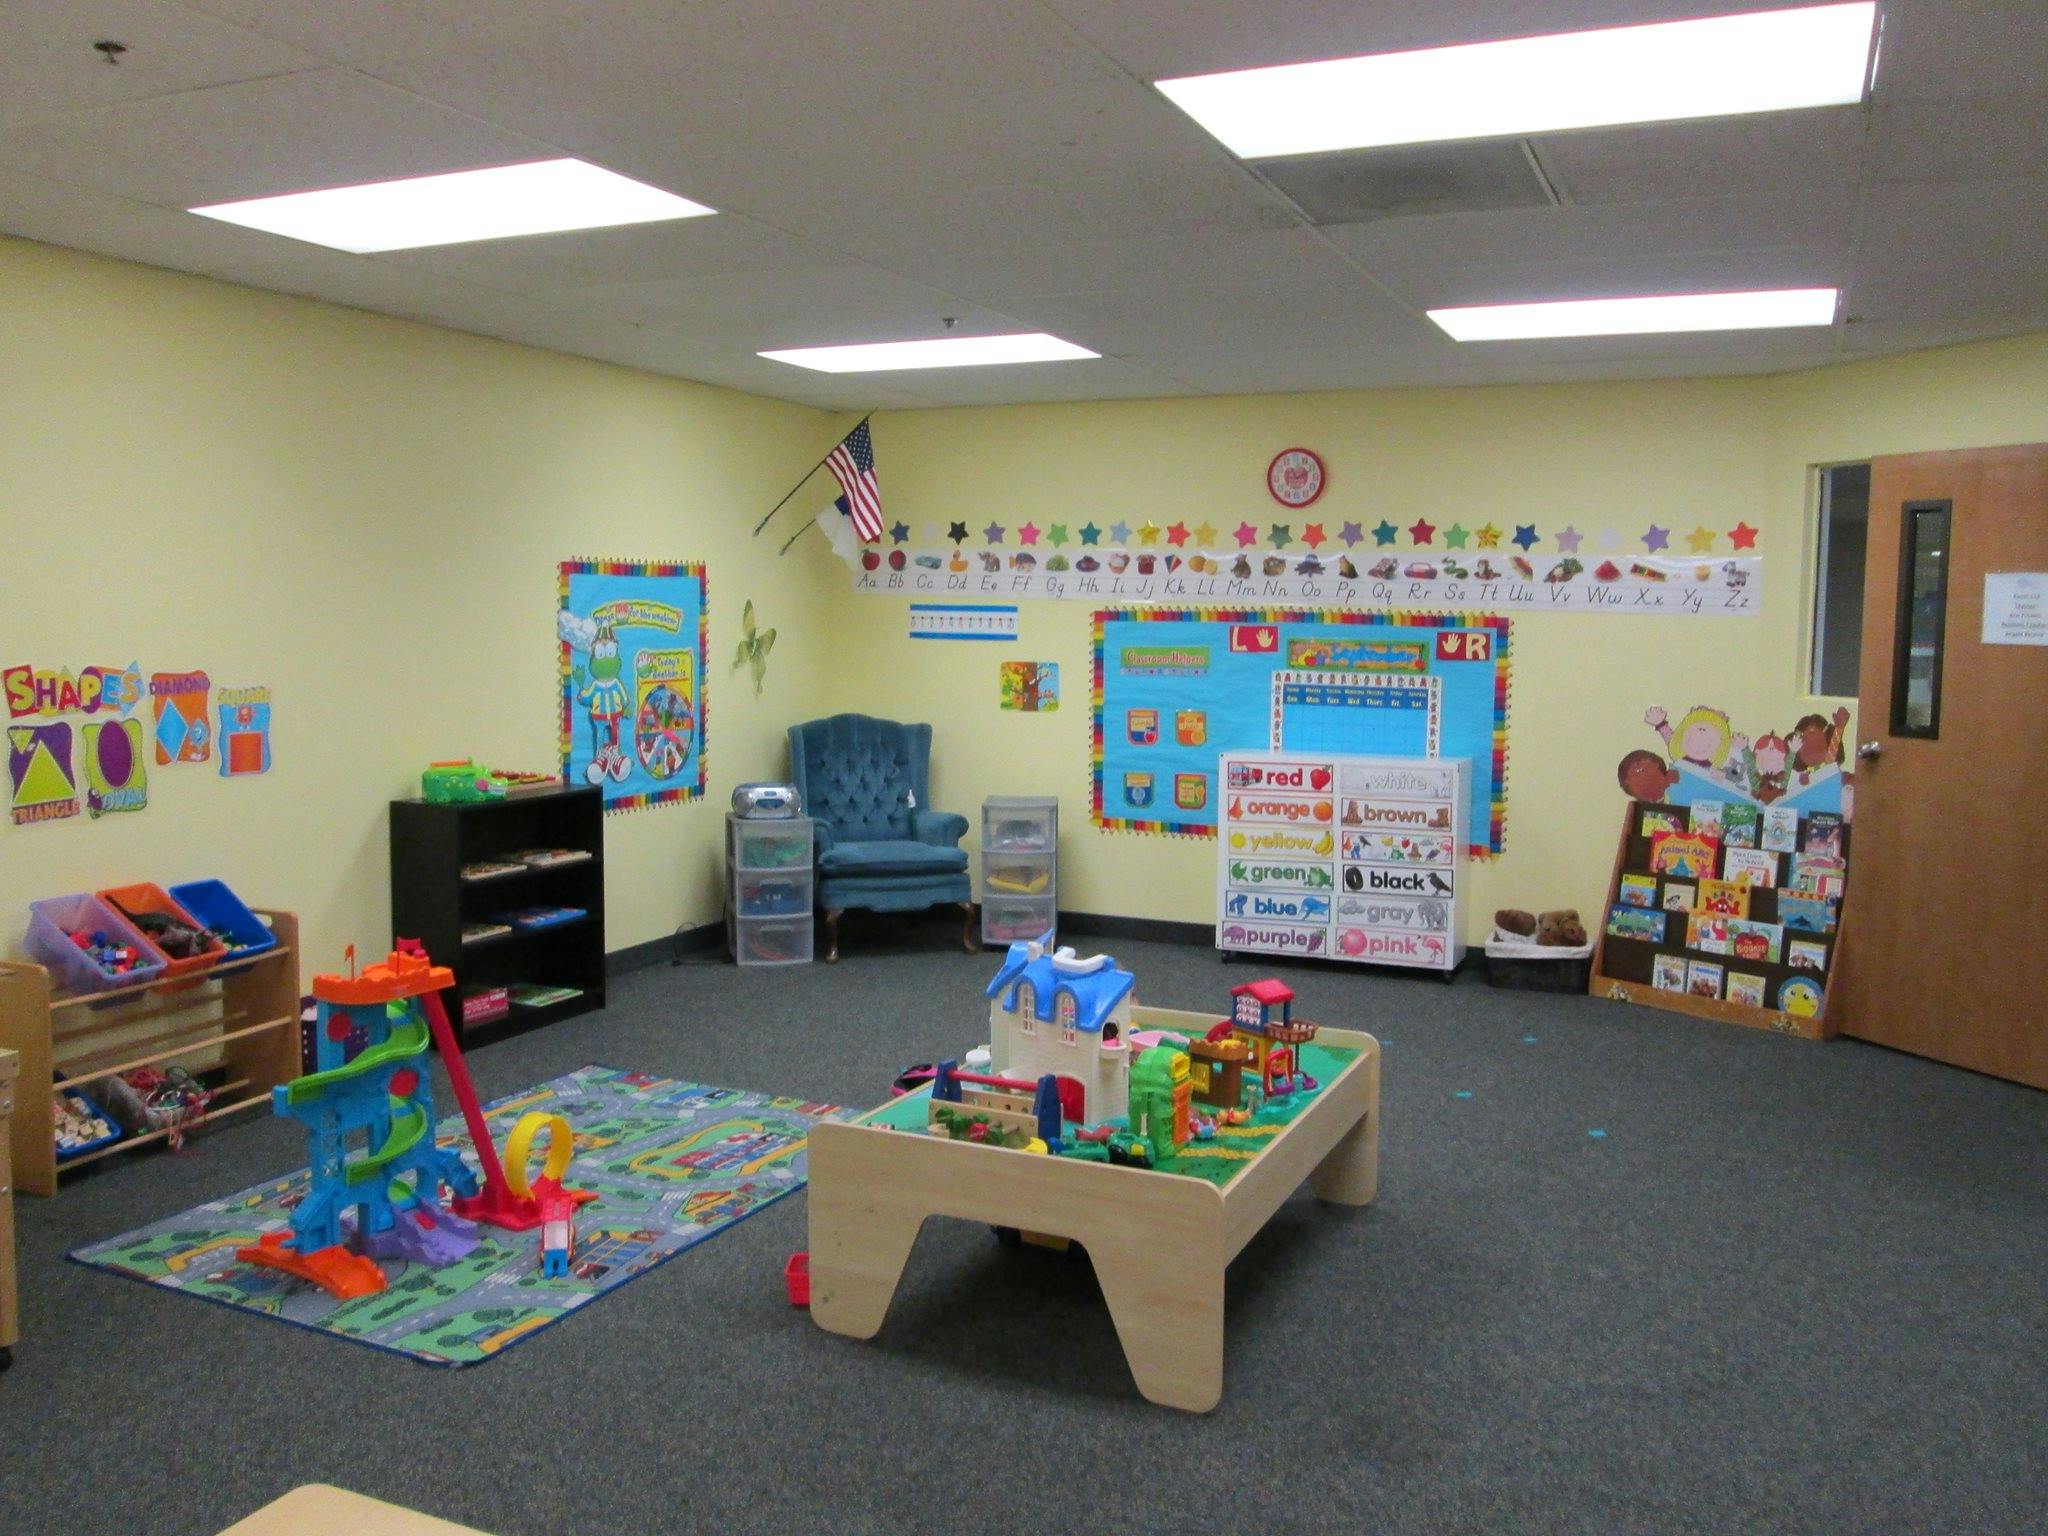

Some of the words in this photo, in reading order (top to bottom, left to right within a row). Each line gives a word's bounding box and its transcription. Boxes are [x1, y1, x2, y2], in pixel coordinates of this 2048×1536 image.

[858, 574, 876, 588] Aa
[888, 574, 904, 588] Bb
[917, 575, 933, 589] Cc
[948, 574, 967, 590] Dd
[980, 575, 997, 590] Ee
[1012, 575, 1032, 590] Ff
[1047, 576, 1064, 598] Gg
[1079, 578, 1099, 592] Hh
[1112, 580, 1124, 593] Ii
[1136, 580, 1154, 599] Jj
[1164, 580, 1186, 594] Kk
[1197, 580, 1215, 595] Ll
[1226, 580, 1256, 596] Mm
[1263, 580, 1288, 596] Nn
[1301, 581, 1321, 597] Oo
[1336, 581, 1356, 604] Pp
[1372, 582, 1392, 604] Qq
[1408, 583, 1431, 599] Rr
[1444, 583, 1465, 600] Ss
[1480, 584, 1498, 601] Tt
[1508, 583, 1534, 601] Uu
[1550, 585, 1571, 602] Vv
[1587, 586, 1623, 605] Ww
[1634, 588, 1664, 606] Xx
[1682, 589, 1702, 613] Yy
[1724, 590, 1749, 608] Zz
[1232, 626, 1248, 651] L
[1466, 633, 1486, 659] R
[1127, 649, 1169, 664] Classroom
[1171, 650, 1205, 665] Helpers
[4, 670, 140, 711] SHAPES
[149, 676, 211, 696] DIAMOND
[1266, 768, 1303, 786] red
[1371, 772, 1429, 789] white
[11, 800, 80, 825] TRIANGLE
[1247, 800, 1310, 819] orange
[1364, 803, 1427, 824] brown
[1250, 832, 1313, 851] yellow
[1251, 863, 1307, 881] green
[1370, 870, 1425, 891] black
[1254, 898, 1297, 915] blue
[1367, 904, 1413, 924] gray
[1247, 928, 1308, 947] purple
[1369, 935, 1418, 955] pink
